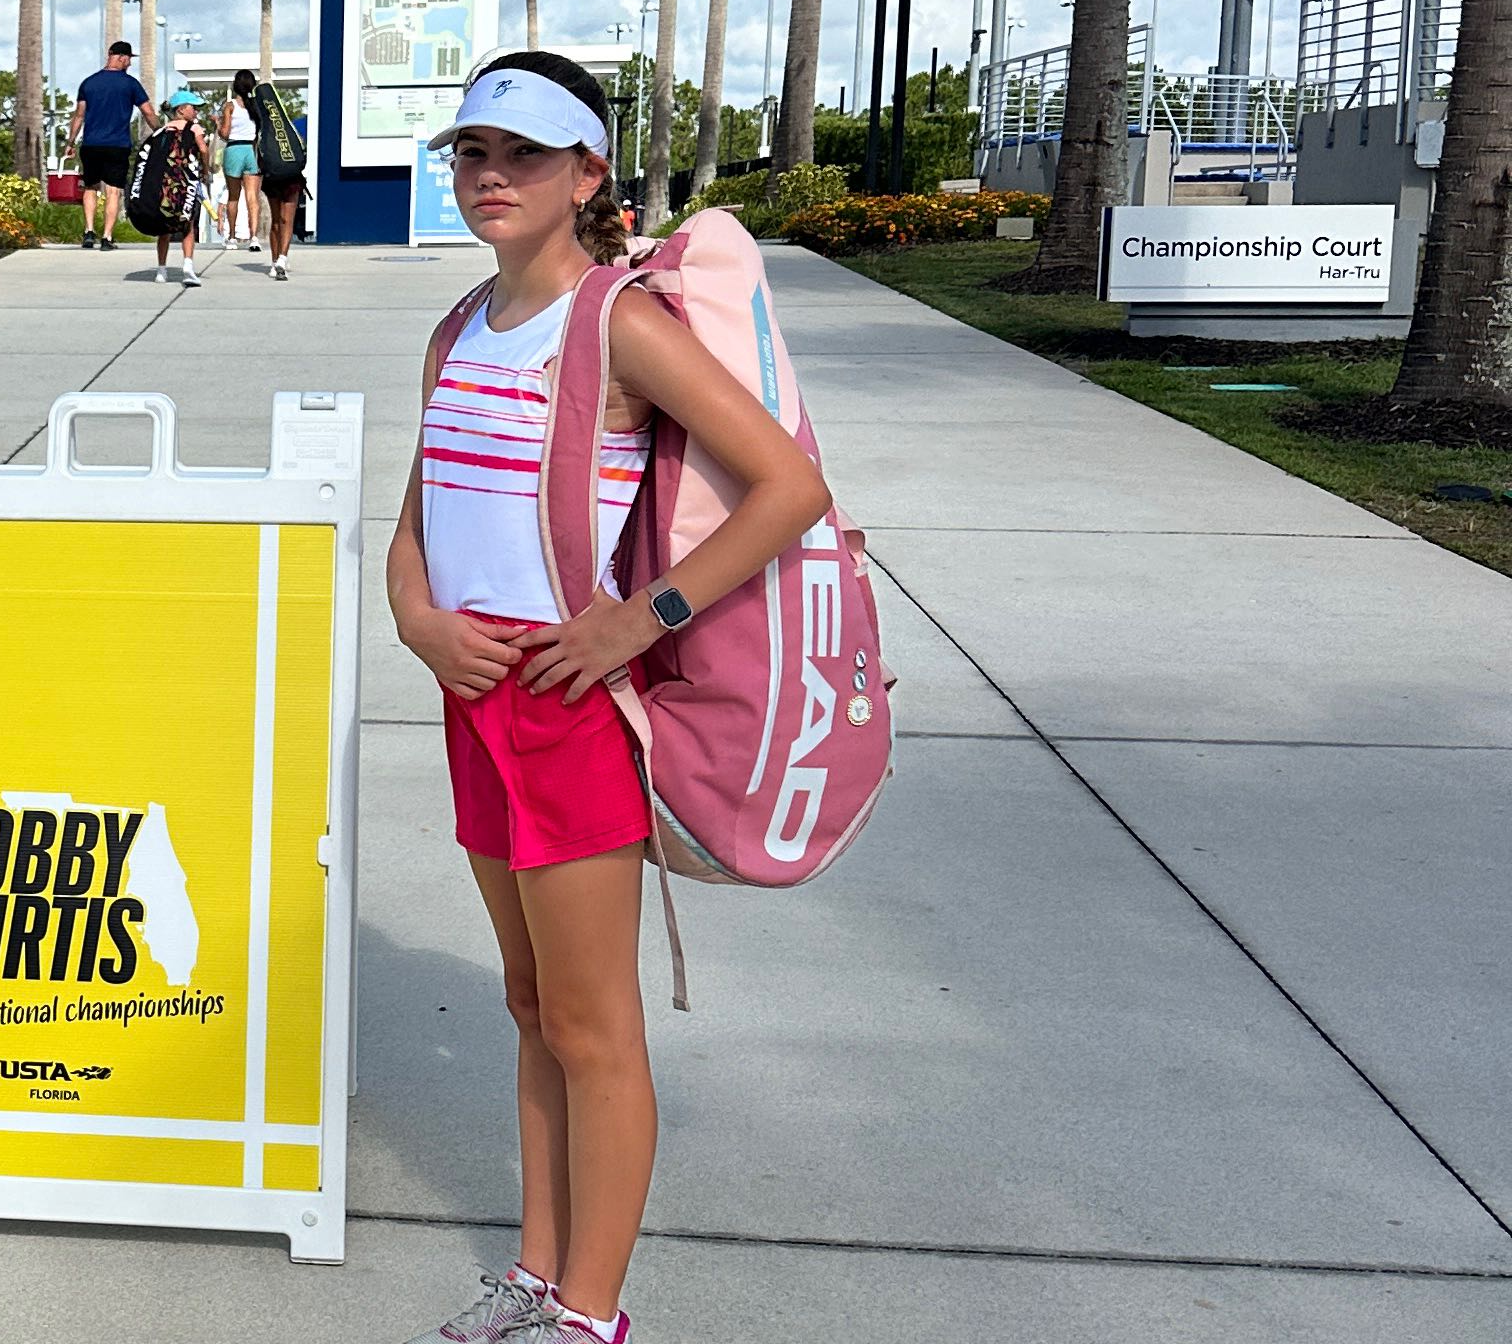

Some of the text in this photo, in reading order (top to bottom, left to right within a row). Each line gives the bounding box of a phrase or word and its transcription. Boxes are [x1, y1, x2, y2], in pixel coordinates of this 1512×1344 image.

[1122, 235, 1383, 262] Championship Court
[1319, 265, 1381, 280] Har-Tru
[65, 989, 225, 1029] championships
[0, 1059, 71, 1082] USTA
[29, 1087, 81, 1102] FLORIDA
